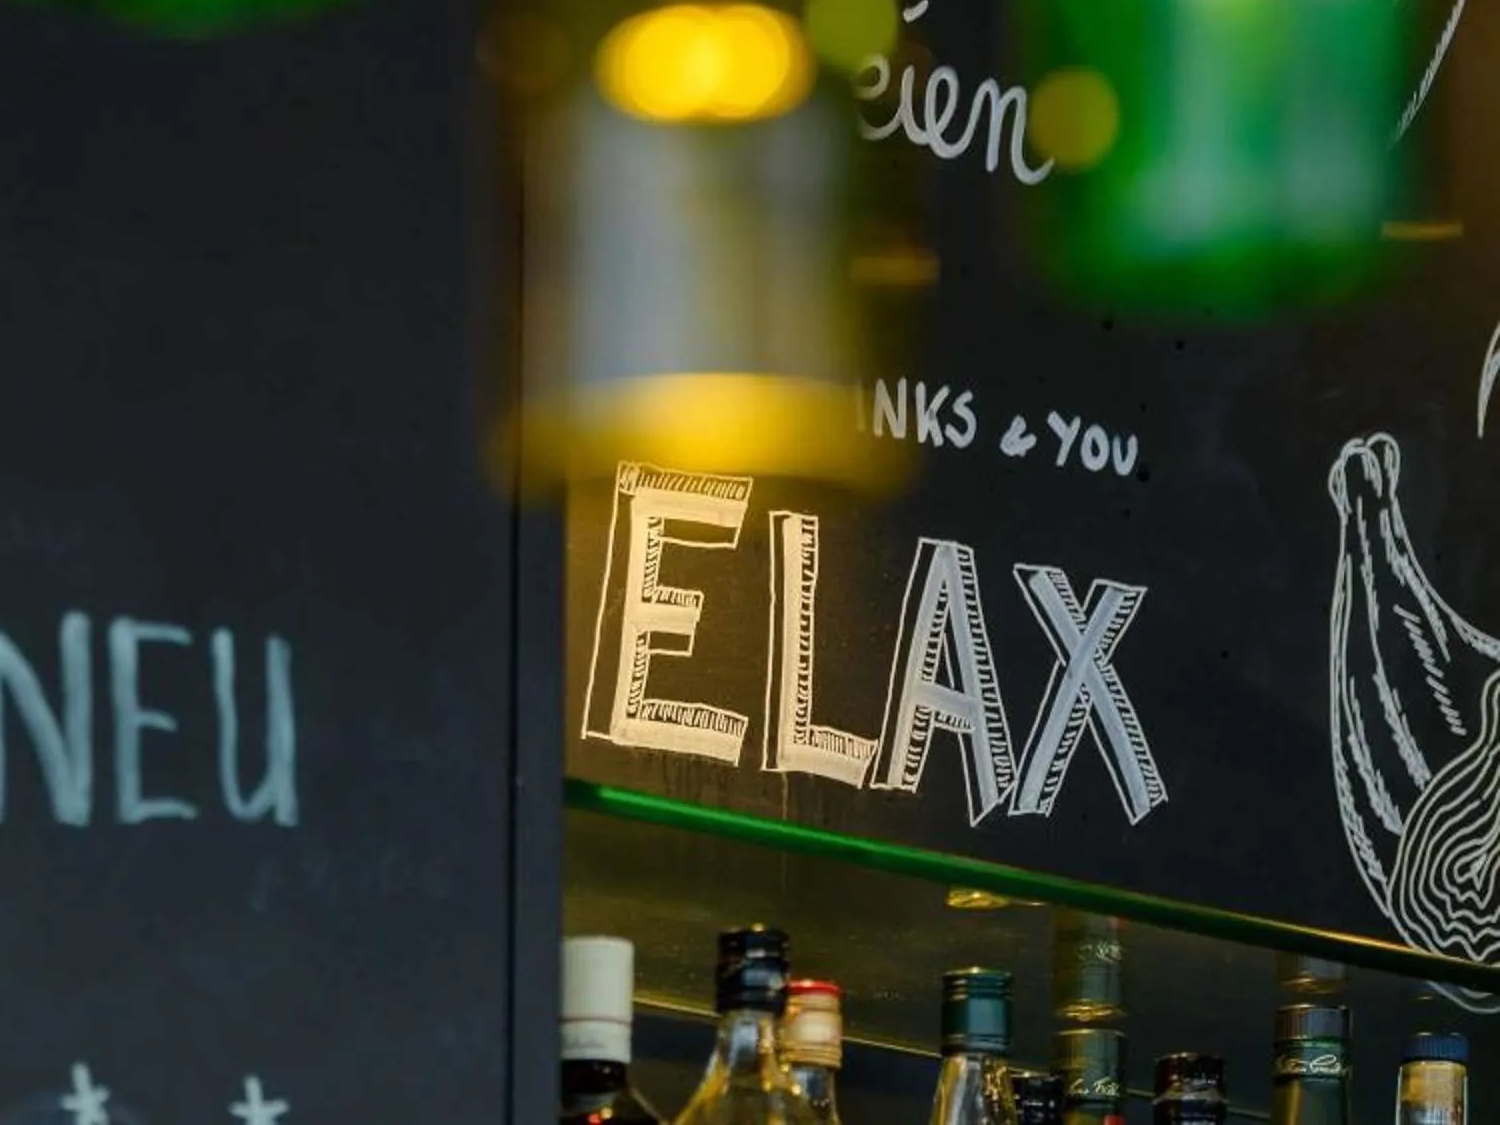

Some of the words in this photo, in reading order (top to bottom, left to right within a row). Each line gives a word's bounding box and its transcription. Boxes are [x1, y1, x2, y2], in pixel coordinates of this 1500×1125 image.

[854, 0, 1055, 185] eien
[1047, 410, 1139, 476] YOU
[582, 461, 1169, 827] ELAX
